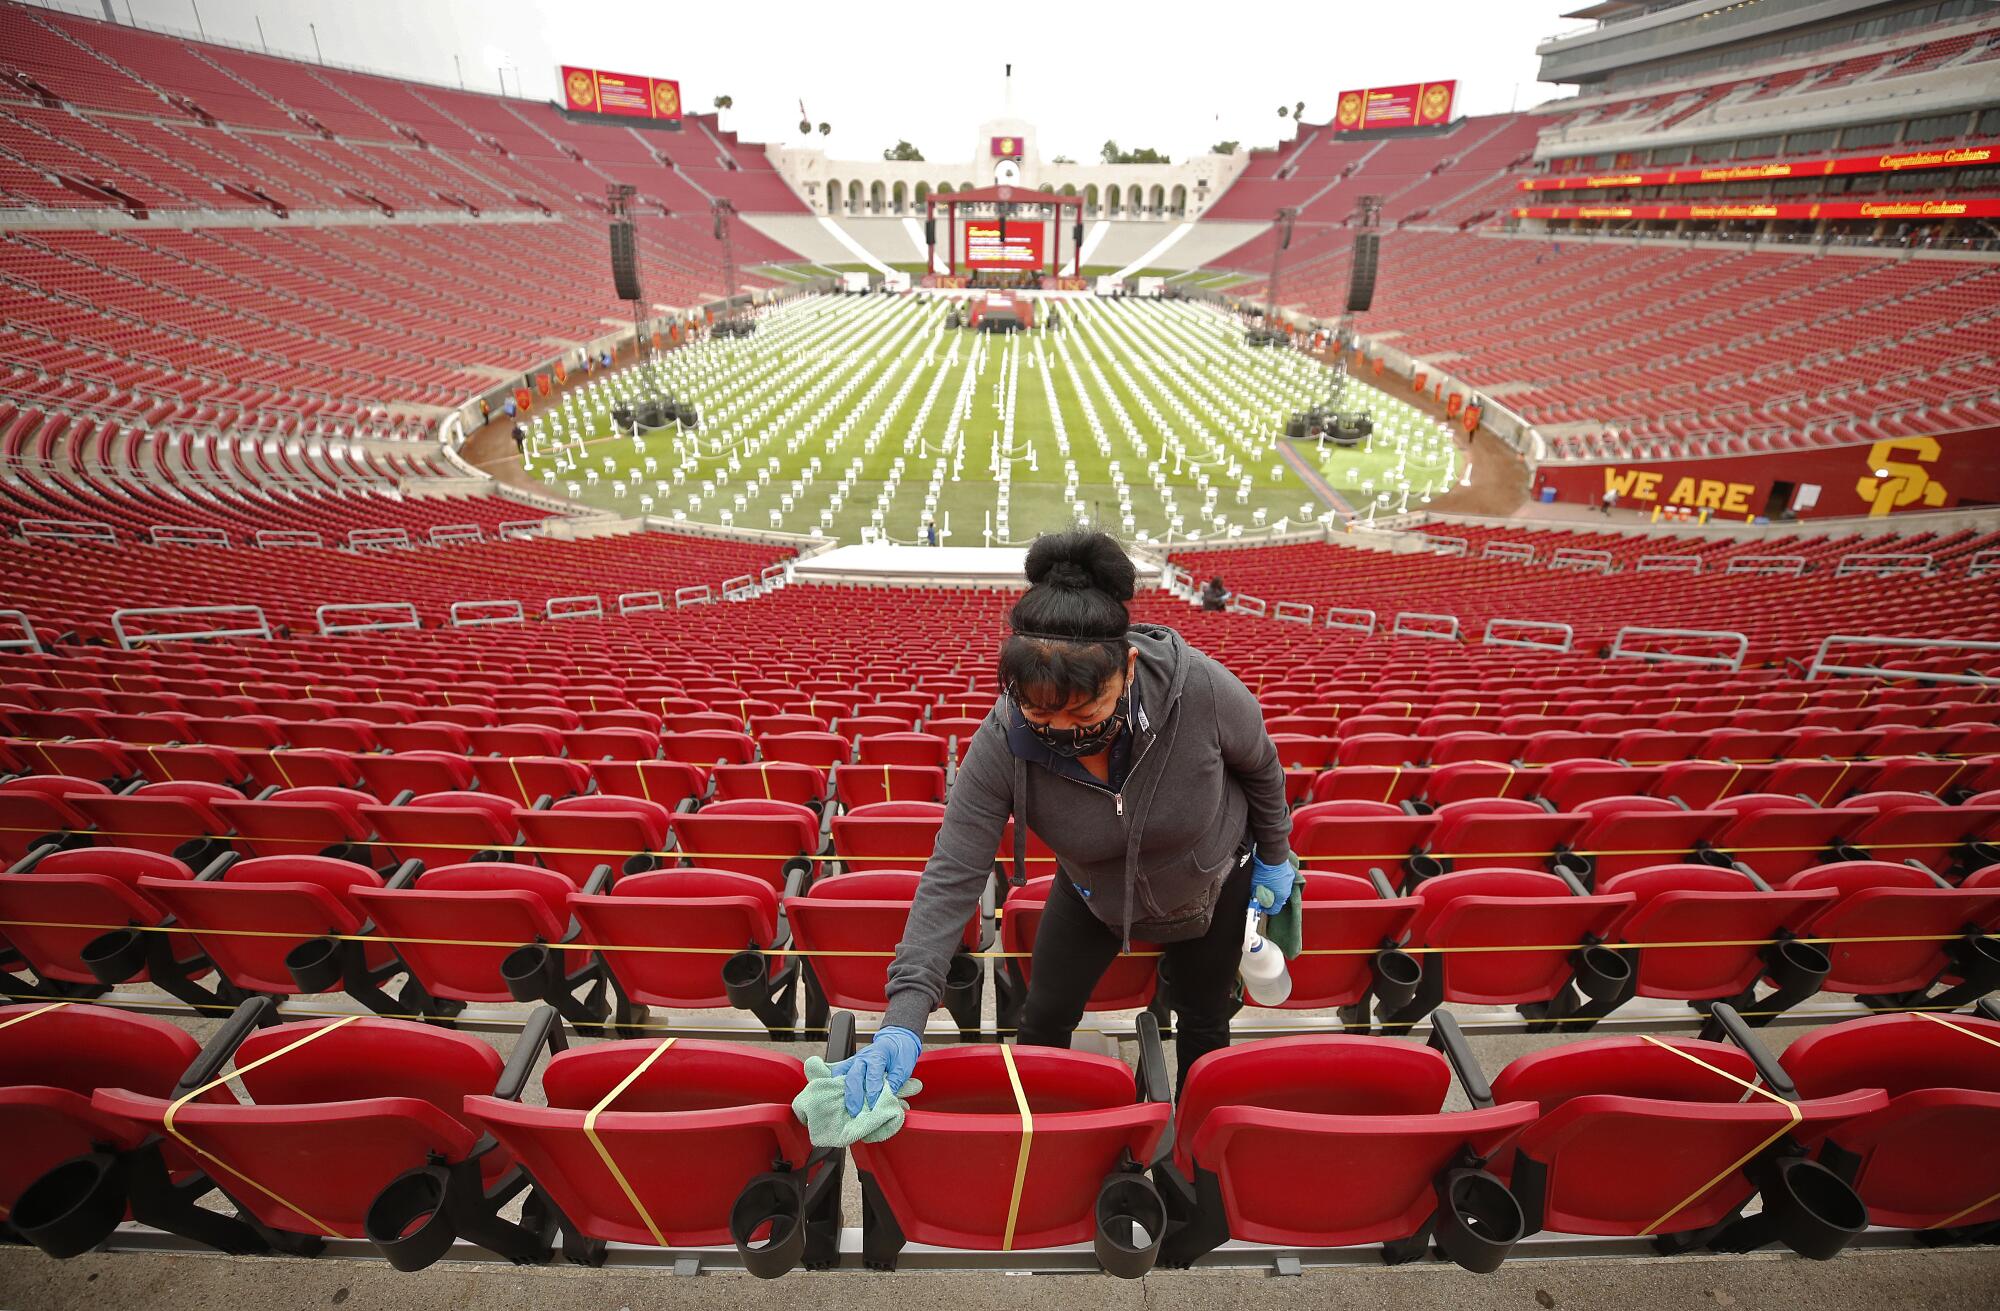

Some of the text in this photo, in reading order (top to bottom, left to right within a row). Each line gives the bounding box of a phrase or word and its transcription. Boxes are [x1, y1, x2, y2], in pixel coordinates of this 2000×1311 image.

[1880, 149, 1990, 170] Congratulations Graduates
[1861, 200, 1966, 218] Congratulations Graduates
[1604, 467, 1755, 513] WE ARE
